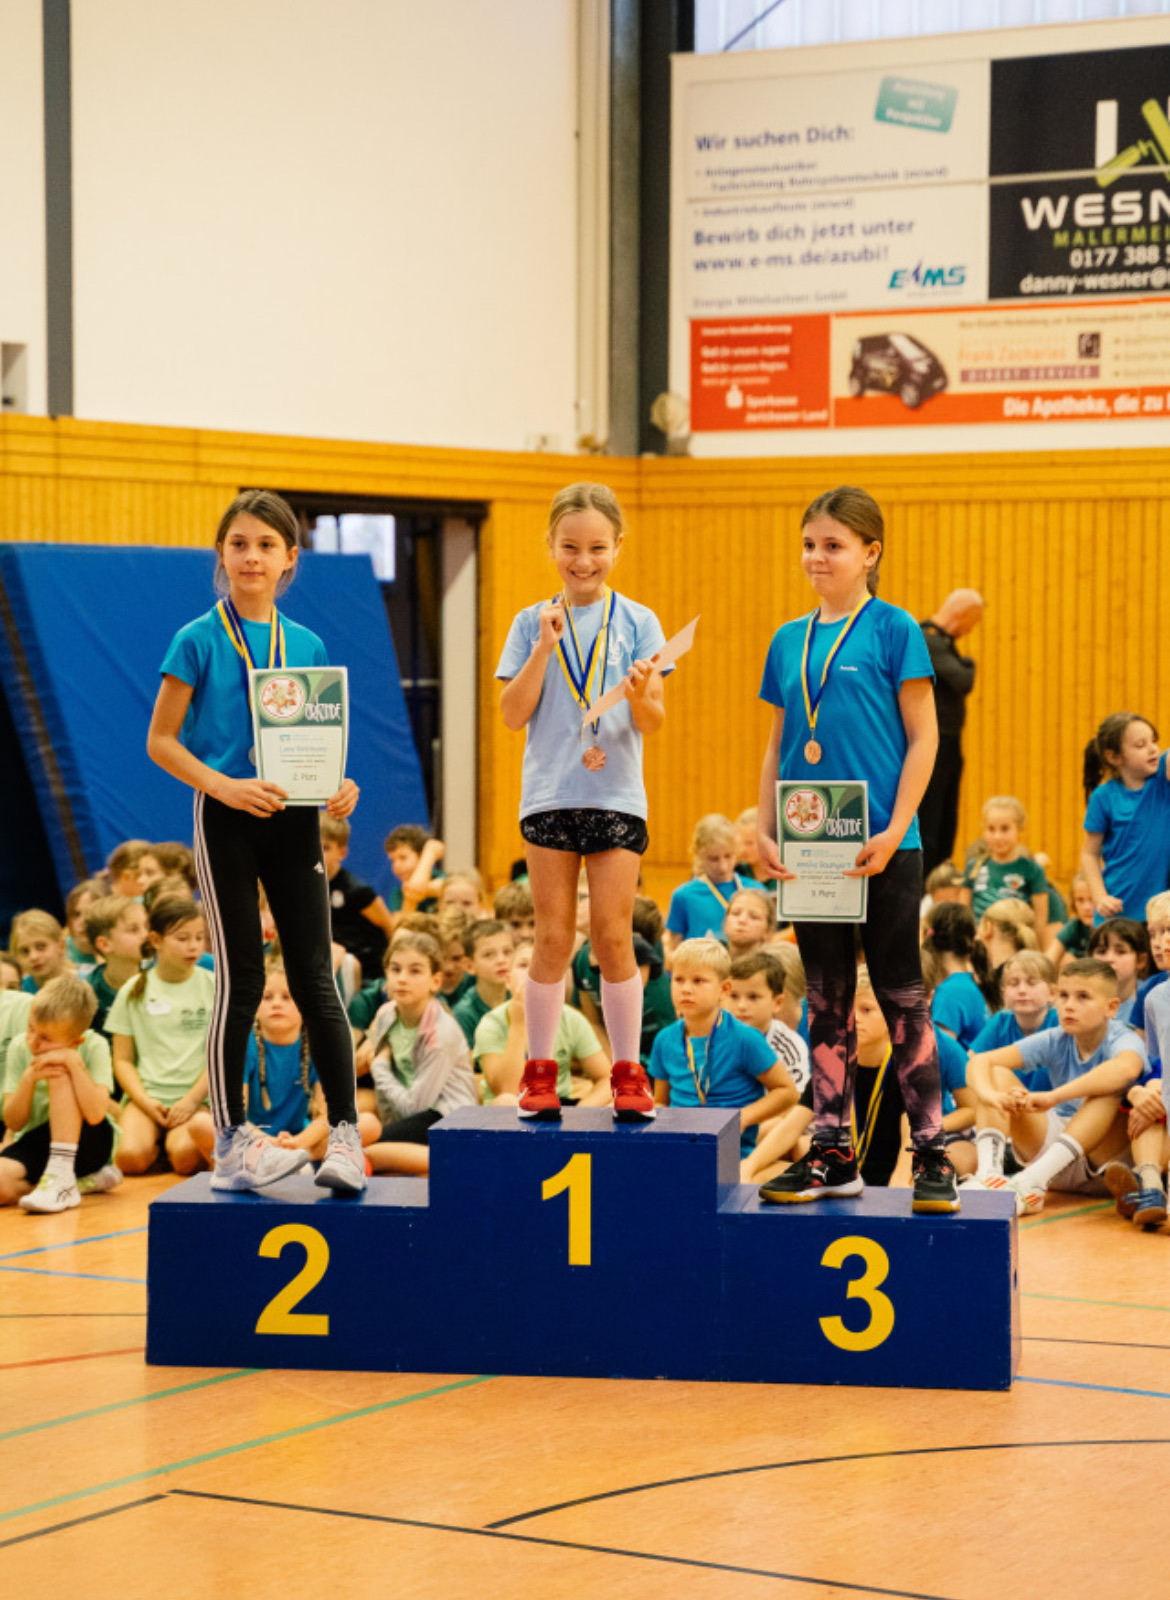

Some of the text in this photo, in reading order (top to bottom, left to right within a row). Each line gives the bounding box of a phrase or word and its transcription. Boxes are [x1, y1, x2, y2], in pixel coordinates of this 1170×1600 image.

[695, 125, 853, 151] Wir suchen Dich:
[694, 220, 914, 246] Bewirb dich jetzt unter
[694, 247, 889, 270] www.e-ms.de/azubi!
[1069, 246, 1119, 269] 0177
[1123, 244, 1160, 266] 388
[1020, 267, 1170, 295] danny-wesner@
[746, 395, 798, 409] Sparkasse
[1003, 396, 1029, 417] Die
[1031, 394, 1111, 419] Apotheke,
[1114, 393, 1140, 413] die
[1143, 396, 1163, 412] zu
[541, 1153, 591, 1266] 1
[255, 1223, 330, 1336] 2
[818, 1235, 895, 1352] 3
